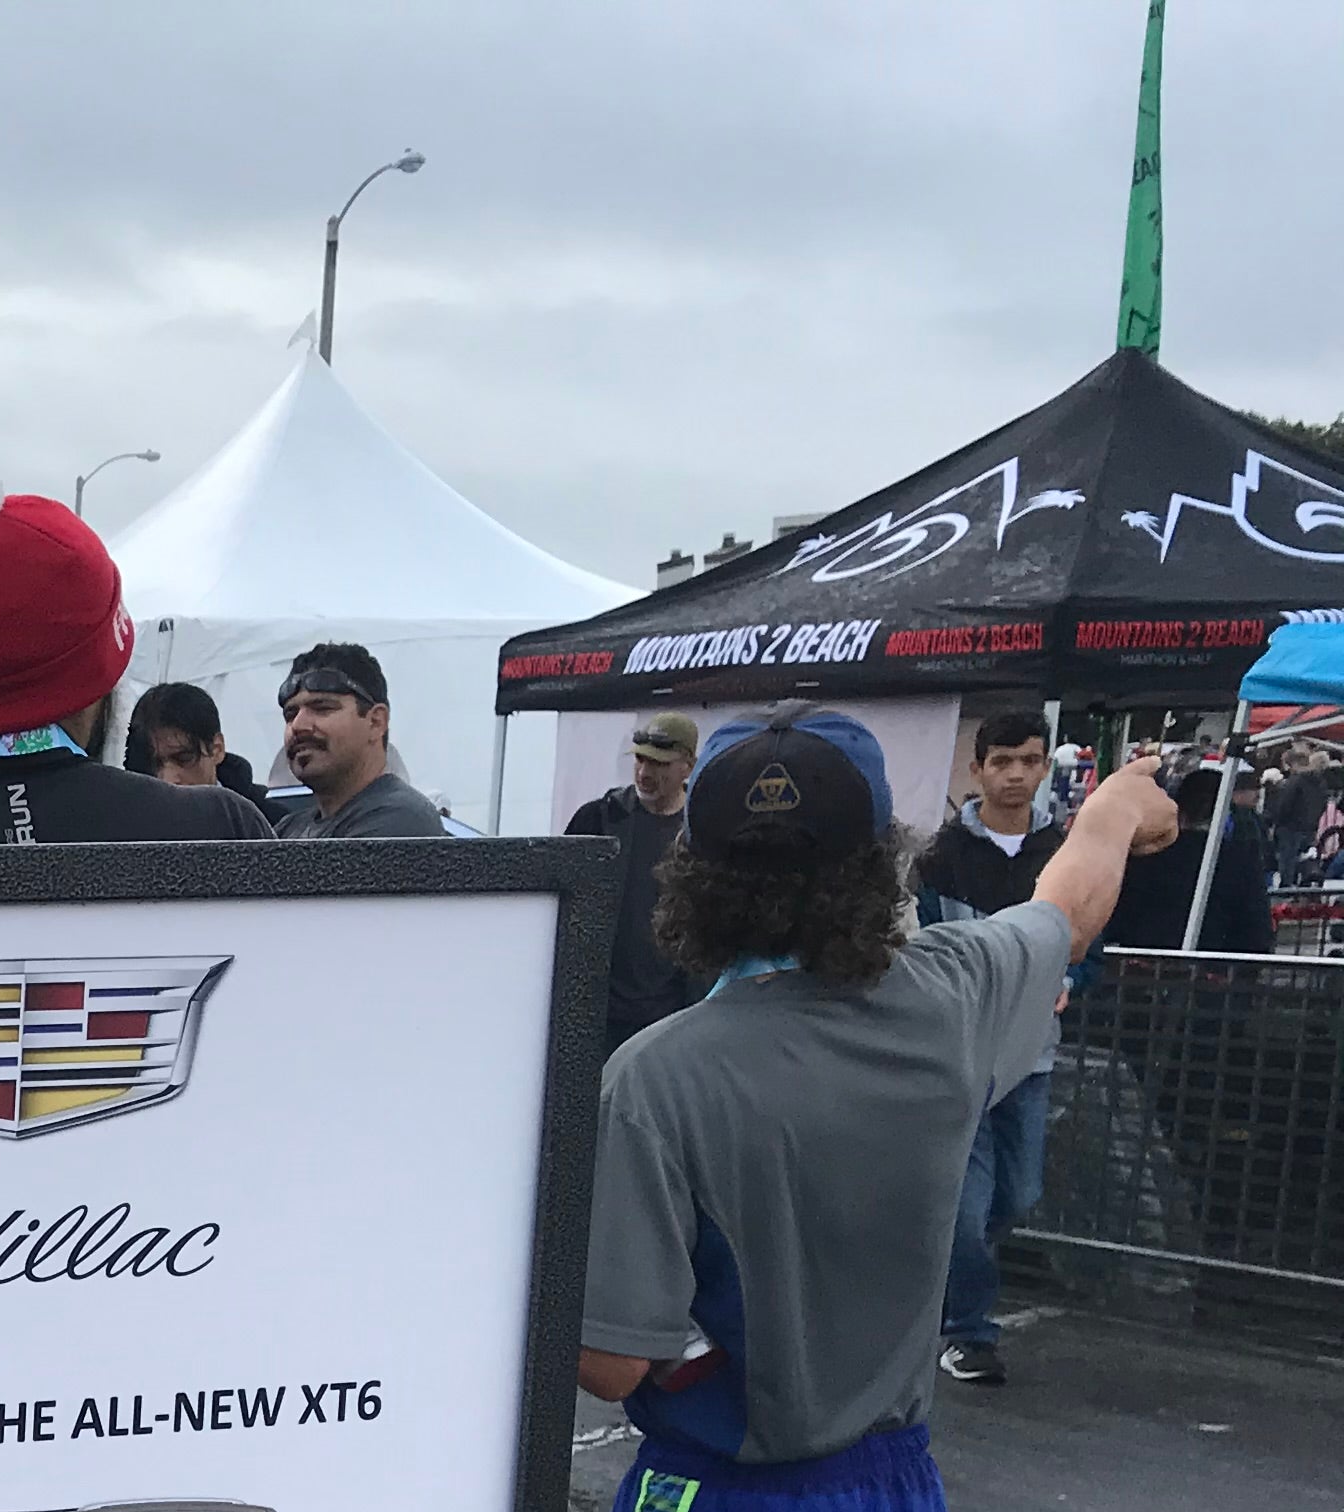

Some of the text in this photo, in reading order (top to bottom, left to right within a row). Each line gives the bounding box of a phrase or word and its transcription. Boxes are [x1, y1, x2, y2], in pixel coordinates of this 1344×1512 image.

[623, 618, 882, 675] MOUNTAINS 2 BEACH
[885, 622, 1043, 657] MOUNTAINS 2 BEACH
[1075, 619, 1264, 650] MOUNTAINS 2 BEACH
[8, 784, 36, 845] RUN
[71, 1387, 286, 1440] ALL-NEW
[299, 1380, 382, 1425] XT6
